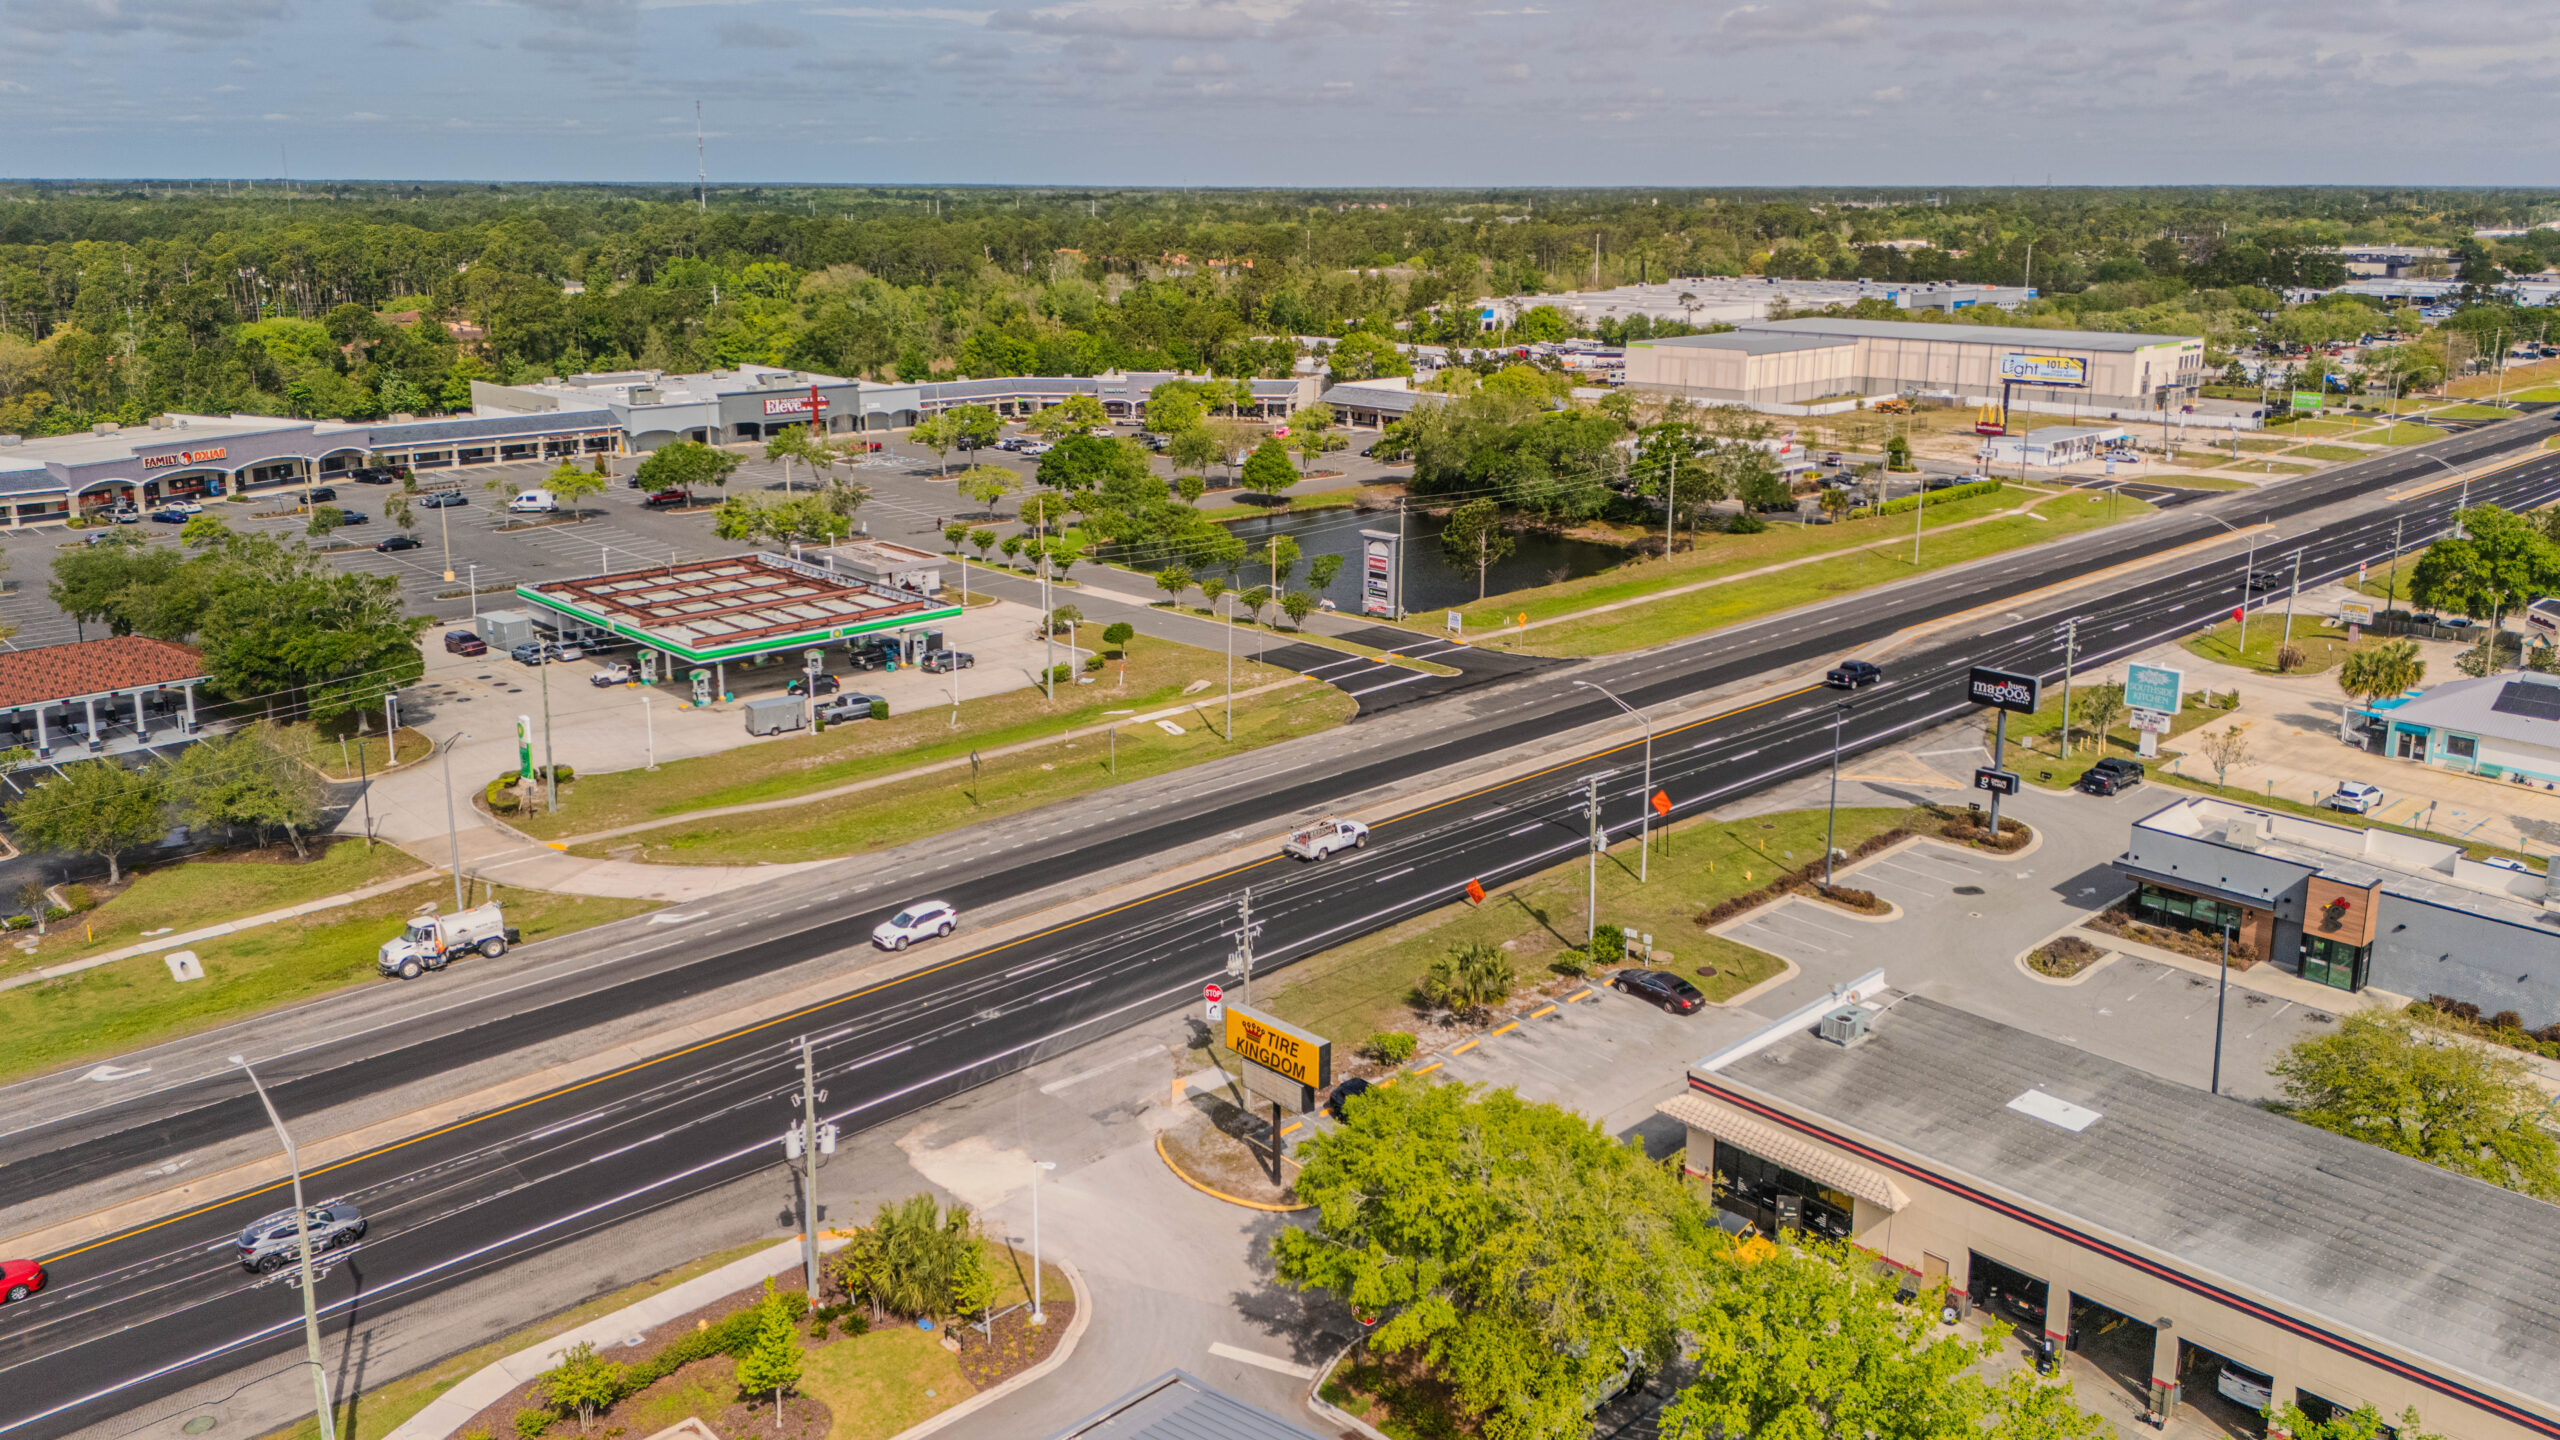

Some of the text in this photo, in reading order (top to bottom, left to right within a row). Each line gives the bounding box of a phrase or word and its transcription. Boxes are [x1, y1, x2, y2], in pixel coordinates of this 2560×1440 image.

[2002, 359, 2039, 378] Light
[2046, 360, 2070, 370] 101.3
[144, 448, 226, 467] FAMILY DOLLAR
[2129, 682, 2175, 698] SOUTHSIDE
[2133, 692, 2169, 705] KITCHEN
[1205, 989, 1221, 997] STOP
[1268, 1031, 1300, 1058] TIRE
[1236, 1037, 1306, 1080] KINGDOM
